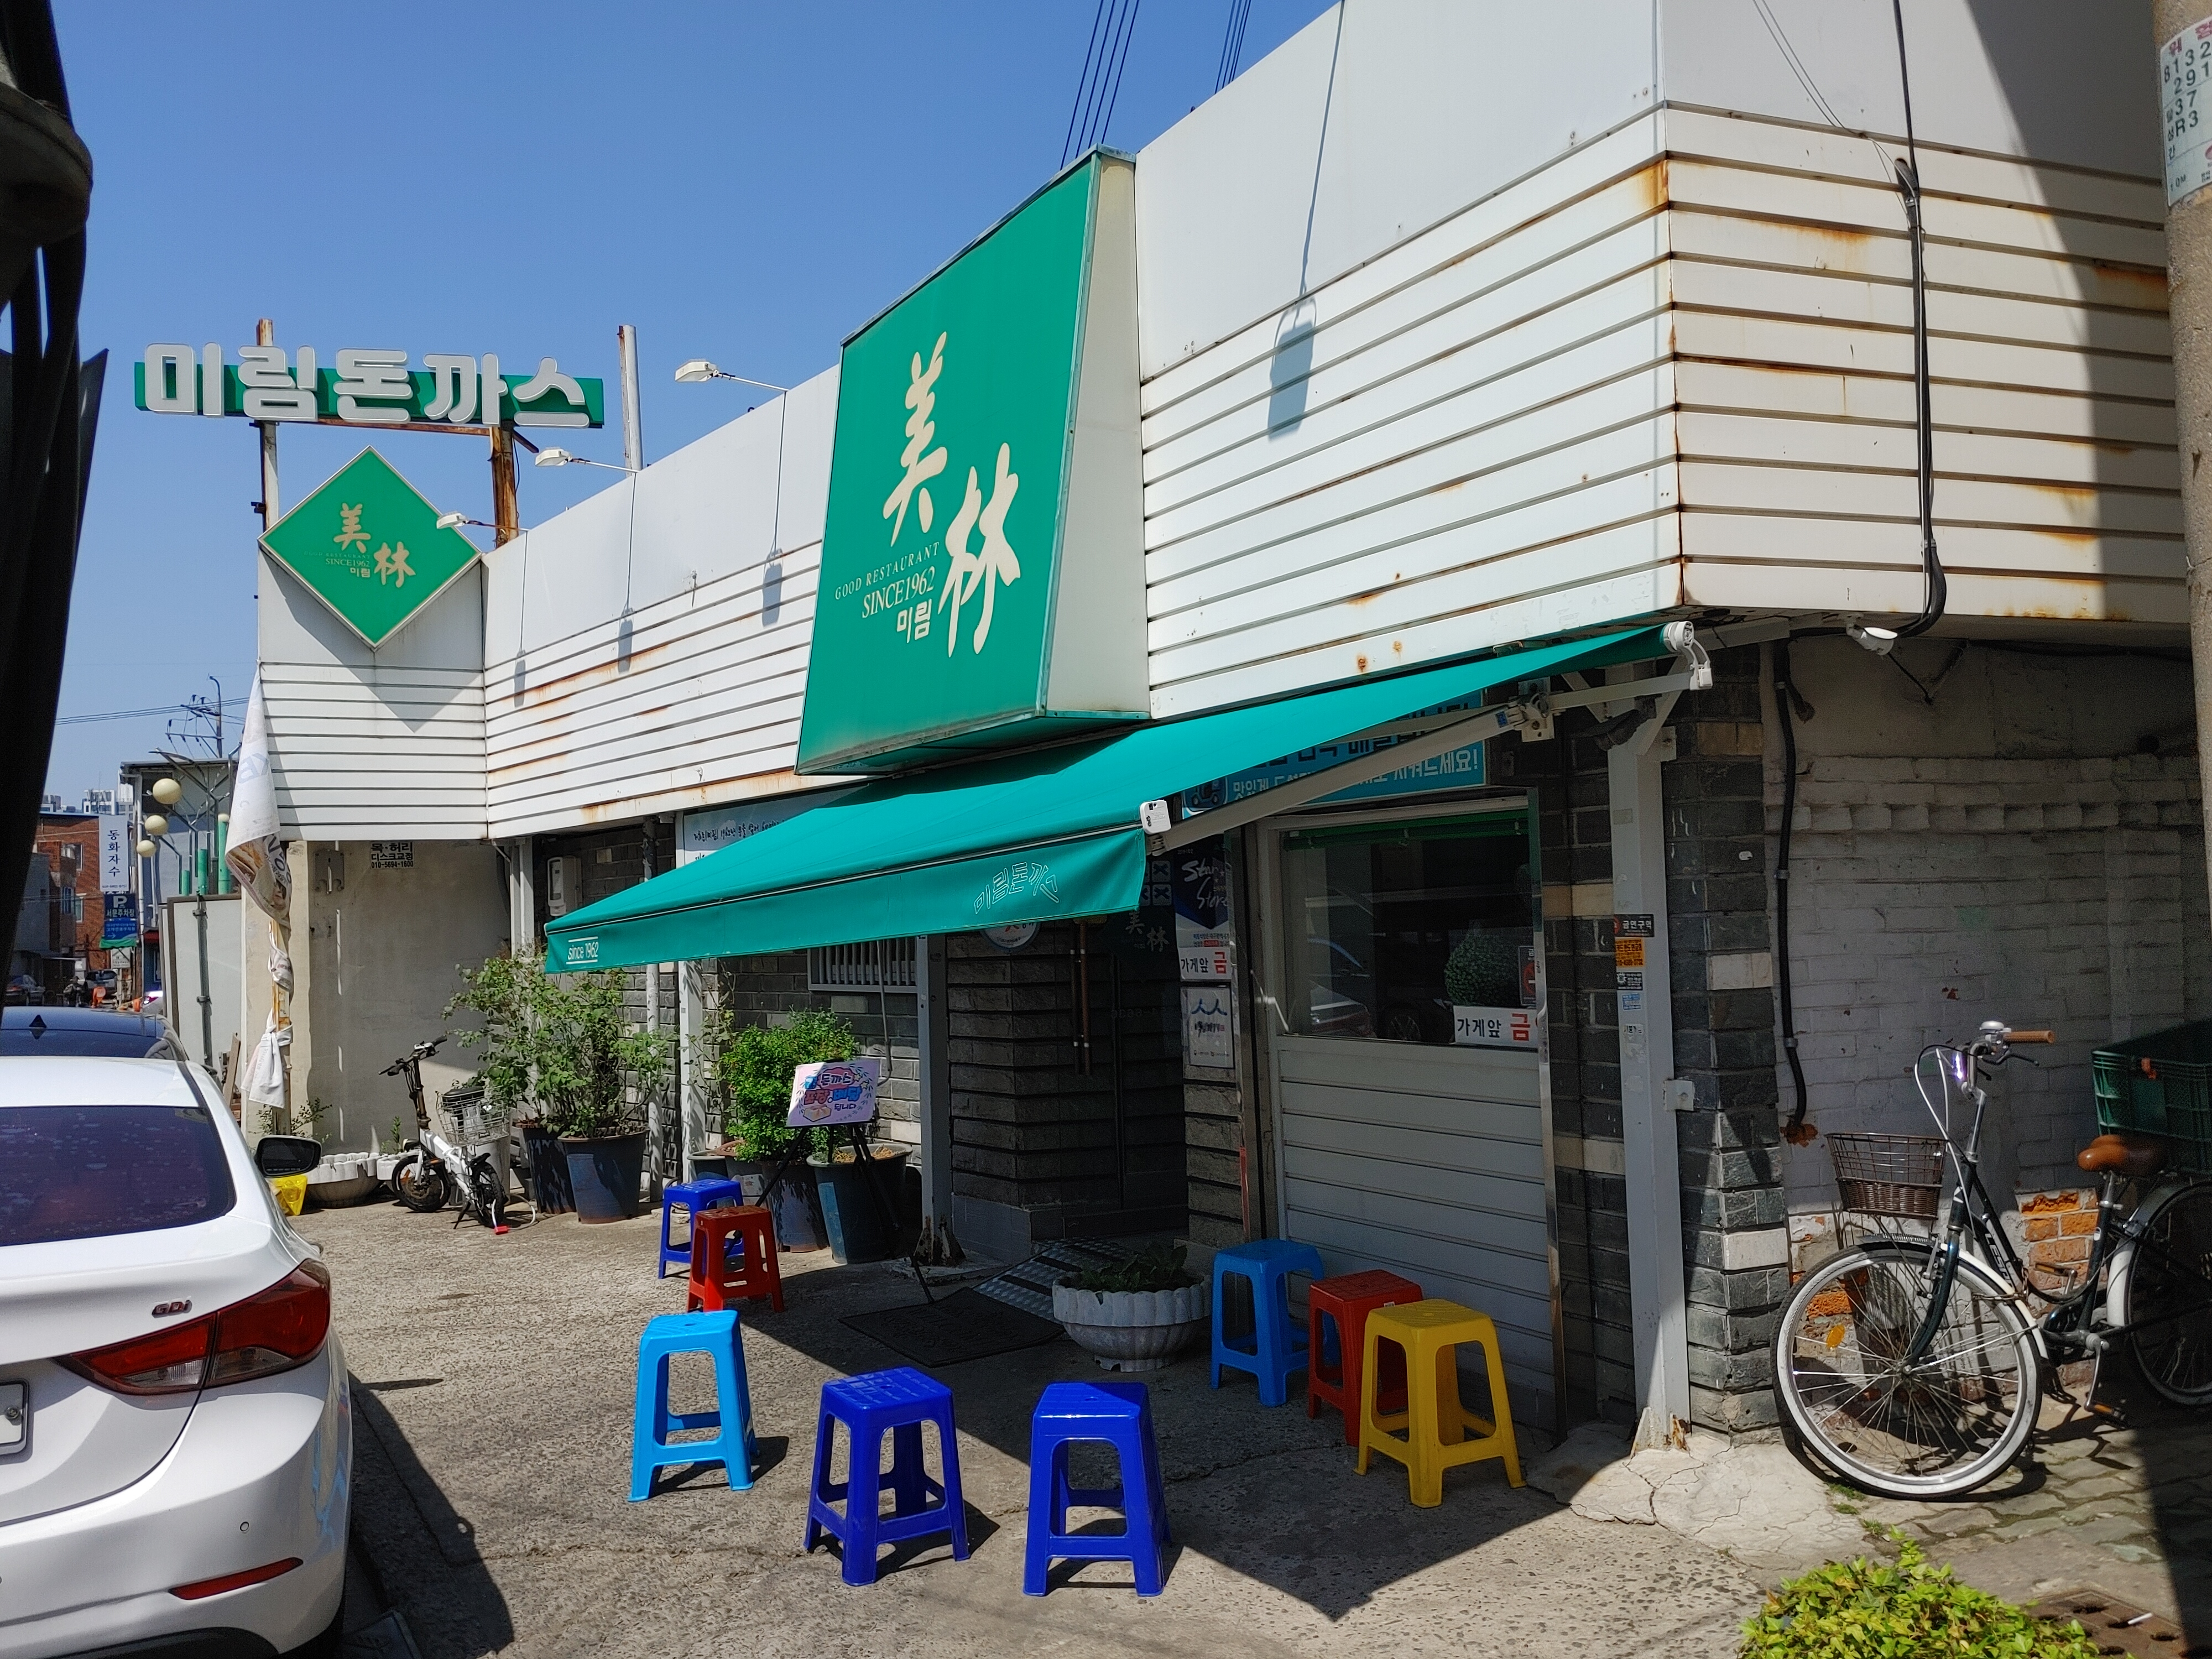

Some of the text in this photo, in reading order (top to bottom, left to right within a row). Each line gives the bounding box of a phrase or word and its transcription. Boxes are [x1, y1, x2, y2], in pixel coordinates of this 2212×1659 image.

[144, 342, 590, 429] 미림돈까스
[883, 331, 1021, 658] 美林
[333, 503, 416, 588] 美林
[325, 558, 371, 567] SINCE1962
[350, 567, 371, 578] 미림
[834, 541, 940, 601] GOOD RESTAURANT
[861, 565, 936, 619] SINCE1962
[896, 598, 933, 643] 미림
[107, 830, 121, 877] 동화자수
[371, 852, 413, 861] 디스크교정
[113, 895, 128, 908] P
[974, 862, 1060, 915] 미림돈까스
[106, 909, 134, 917] 서문주차장
[1622, 920, 1652, 929] 금연구역
[567, 942, 599, 960] since 1962
[1181, 957, 1208, 973] 가게앞
[1457, 1013, 1537, 1041] 가게앞 금
